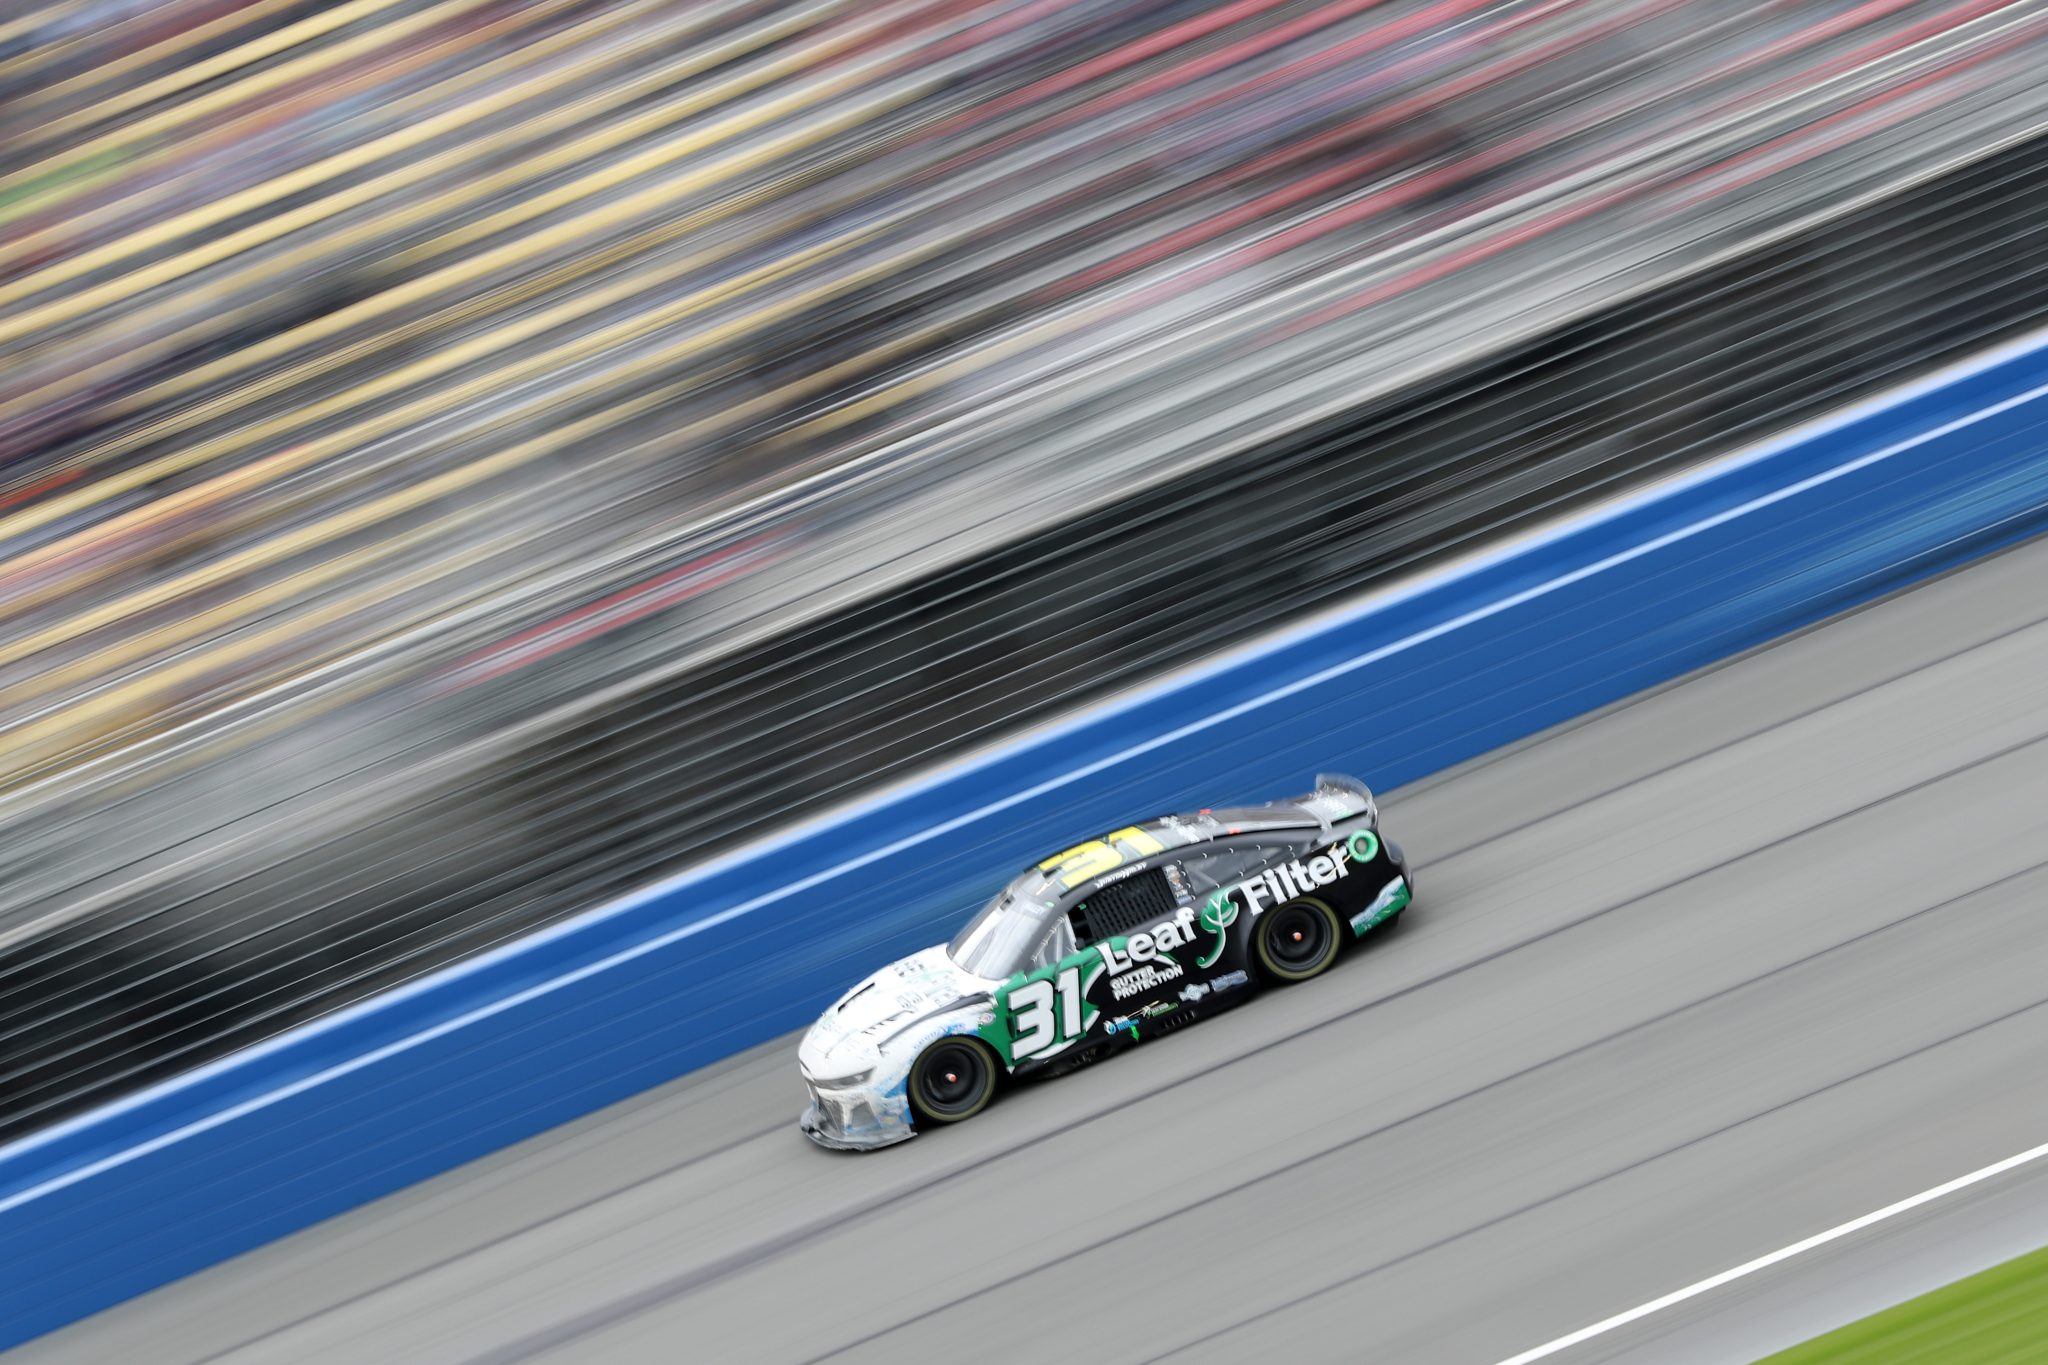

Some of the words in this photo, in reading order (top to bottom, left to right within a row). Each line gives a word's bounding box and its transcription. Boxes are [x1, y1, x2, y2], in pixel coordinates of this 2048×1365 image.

[1098, 907, 1197, 976] Leaf
[1239, 846, 1350, 917] Filter
[1109, 964, 1156, 990] GUTTER
[1112, 963, 1184, 1002] PROTECTION
[1008, 967, 1081, 1061] 31
